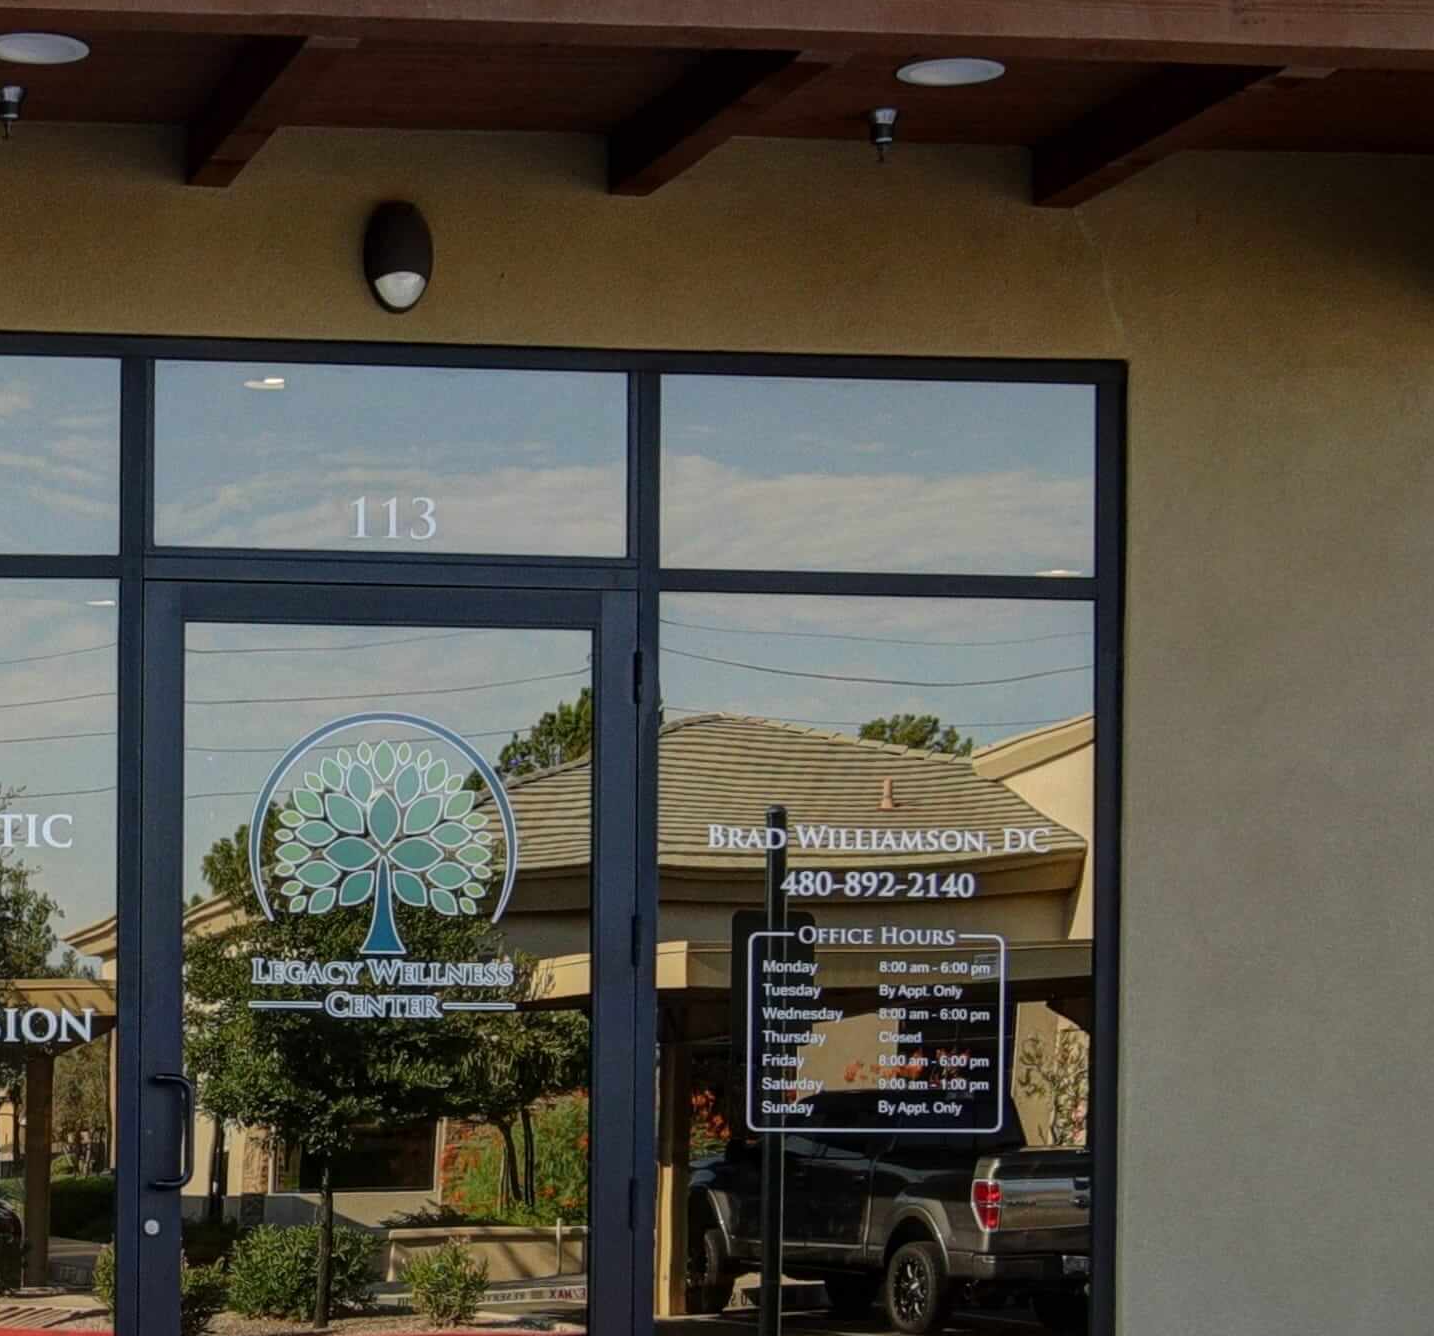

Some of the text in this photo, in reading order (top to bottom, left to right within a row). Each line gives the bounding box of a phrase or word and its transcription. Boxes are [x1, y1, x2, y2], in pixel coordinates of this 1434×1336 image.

[349, 496, 437, 540] 113
[707, 824, 1052, 855] BRAD WILLIAMSON, DC
[780, 871, 975, 898] 480-892-2140
[798, 926, 956, 946] OFFICE HOURS
[251, 958, 514, 986] LEGACY WELLNESS
[762, 960, 818, 975] Monday
[879, 961, 906, 973] 8:00
[909, 964, 929, 973] am
[940, 962, 968, 973] 6:00
[971, 964, 991, 976] pm
[762, 983, 963, 999] Tuesday By Appt. Only
[325, 992, 443, 1018] CENTER
[762, 1007, 843, 1022] Wednesday
[879, 1008, 906, 1020] 8:00
[909, 1010, 929, 1020] am
[940, 1008, 967, 1020] 6:00
[970, 1011, 990, 1022] pm
[762, 1030, 922, 1046] Thursday Closed
[762, 1054, 804, 1069] Friday
[908, 1057, 928, 1067] am
[940, 1055, 967, 1067] 6:00
[970, 1058, 990, 1069] pm
[762, 1077, 824, 1093] Saturday
[878, 1078, 906, 1090] 9:00
[908, 1081, 928, 1090] am
[941, 1078, 966, 1090] 1:00
[969, 1081, 989, 1092] pm
[762, 1100, 962, 1116] Sunday By Appt. Only
